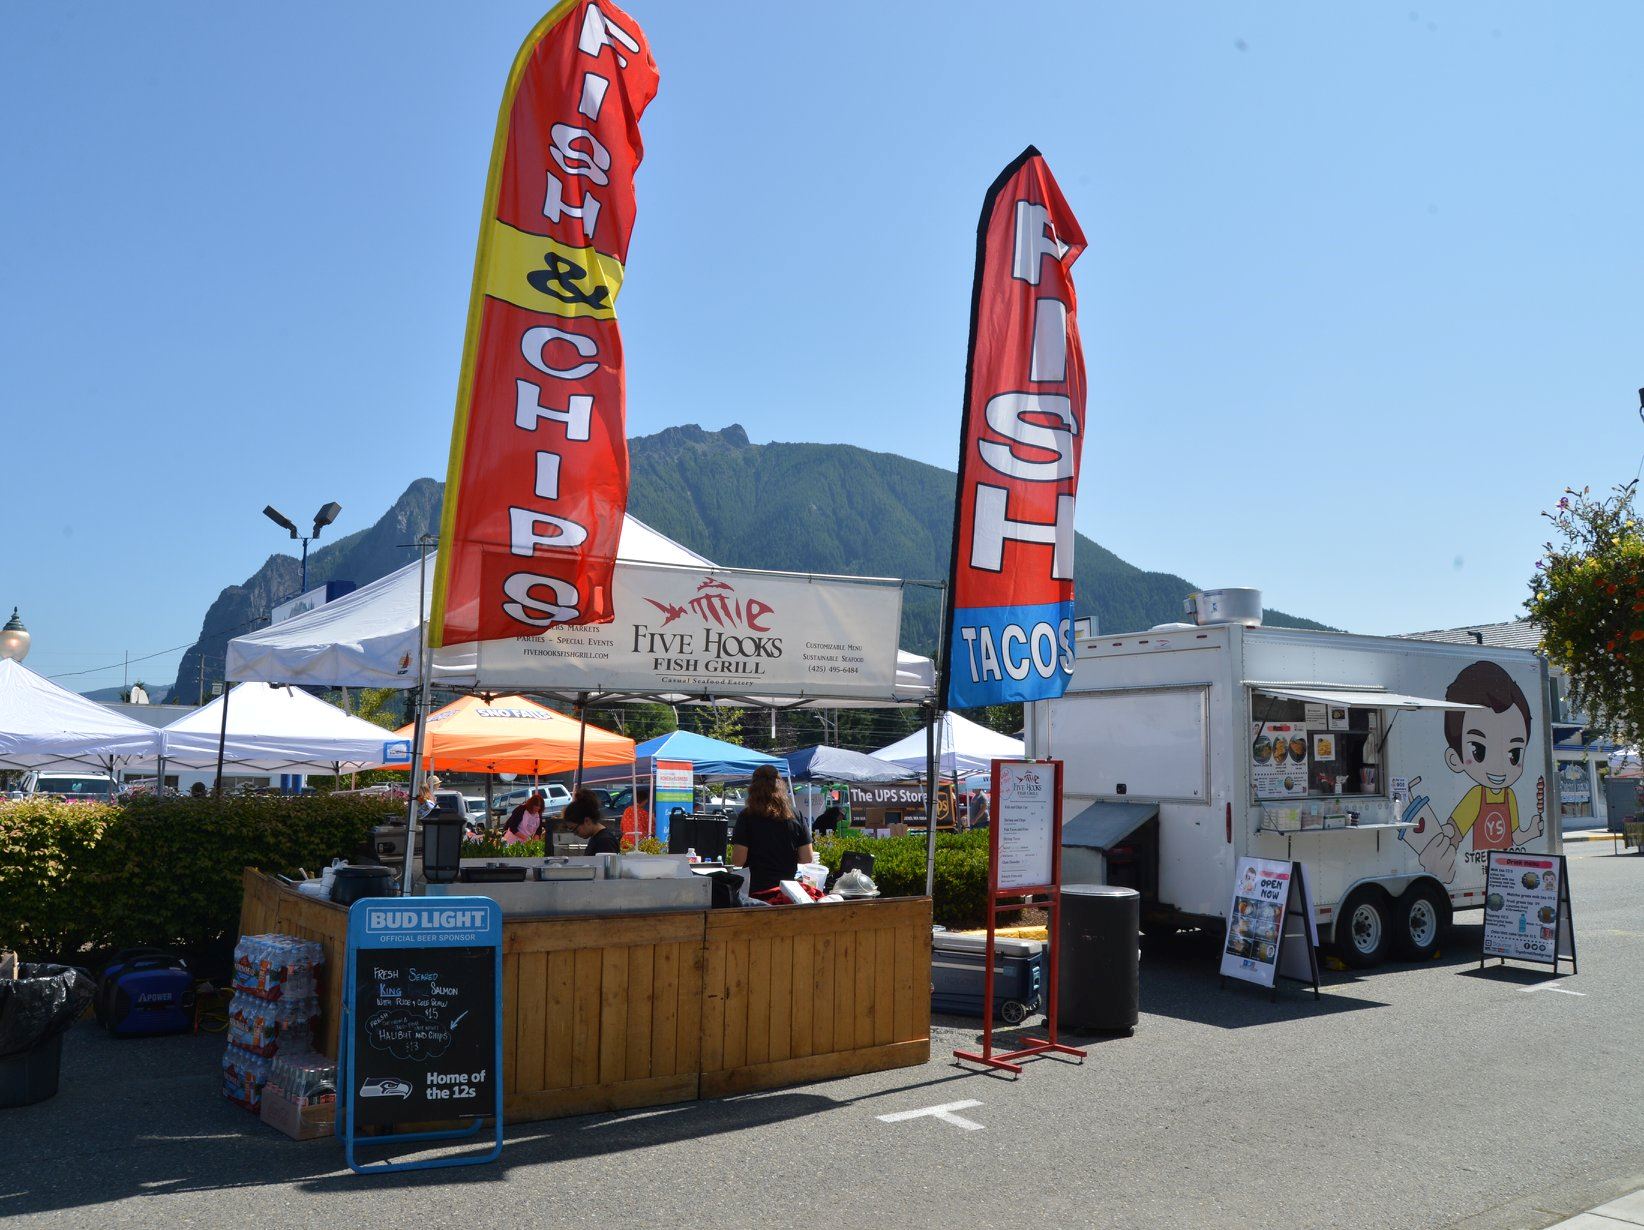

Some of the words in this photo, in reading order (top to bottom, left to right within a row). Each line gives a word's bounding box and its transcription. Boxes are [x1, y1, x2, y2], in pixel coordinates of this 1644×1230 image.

[542, 2, 640, 240] FISH
[969, 199, 1079, 582] FISH
[502, 325, 599, 627] CHIPS
[557, 636, 585, 645] SPECIAL
[588, 638, 614, 647] EVENTS
[632, 624, 694, 655] FIVE
[703, 627, 783, 659] HOOKS
[961, 617, 1075, 683] TACOS
[653, 657, 699, 672] FISH
[704, 659, 766, 674] GRILL
[851, 789, 873, 802] The
[875, 789, 898, 802] UPS
[899, 789, 927, 802] Store
[1486, 820, 1504, 835] YS
[1260, 879, 1283, 890] OPEN
[1260, 888, 1280, 900] NOW
[370, 911, 418, 929] BUD
[421, 911, 485, 928] LIGHT
[417, 934, 437, 942] BEER
[438, 933, 476, 942] SPONSOR
[373, 967, 399, 980] FRESH
[408, 967, 438, 982] SEARED
[380, 982, 402, 996] KING
[430, 982, 459, 995] SALMON
[379, 1029, 412, 1041] HALIBUT
[426, 1071, 469, 1084] Home
[471, 1069, 486, 1082] of
[426, 1086, 450, 1100] the
[452, 1084, 477, 1098] 12s
